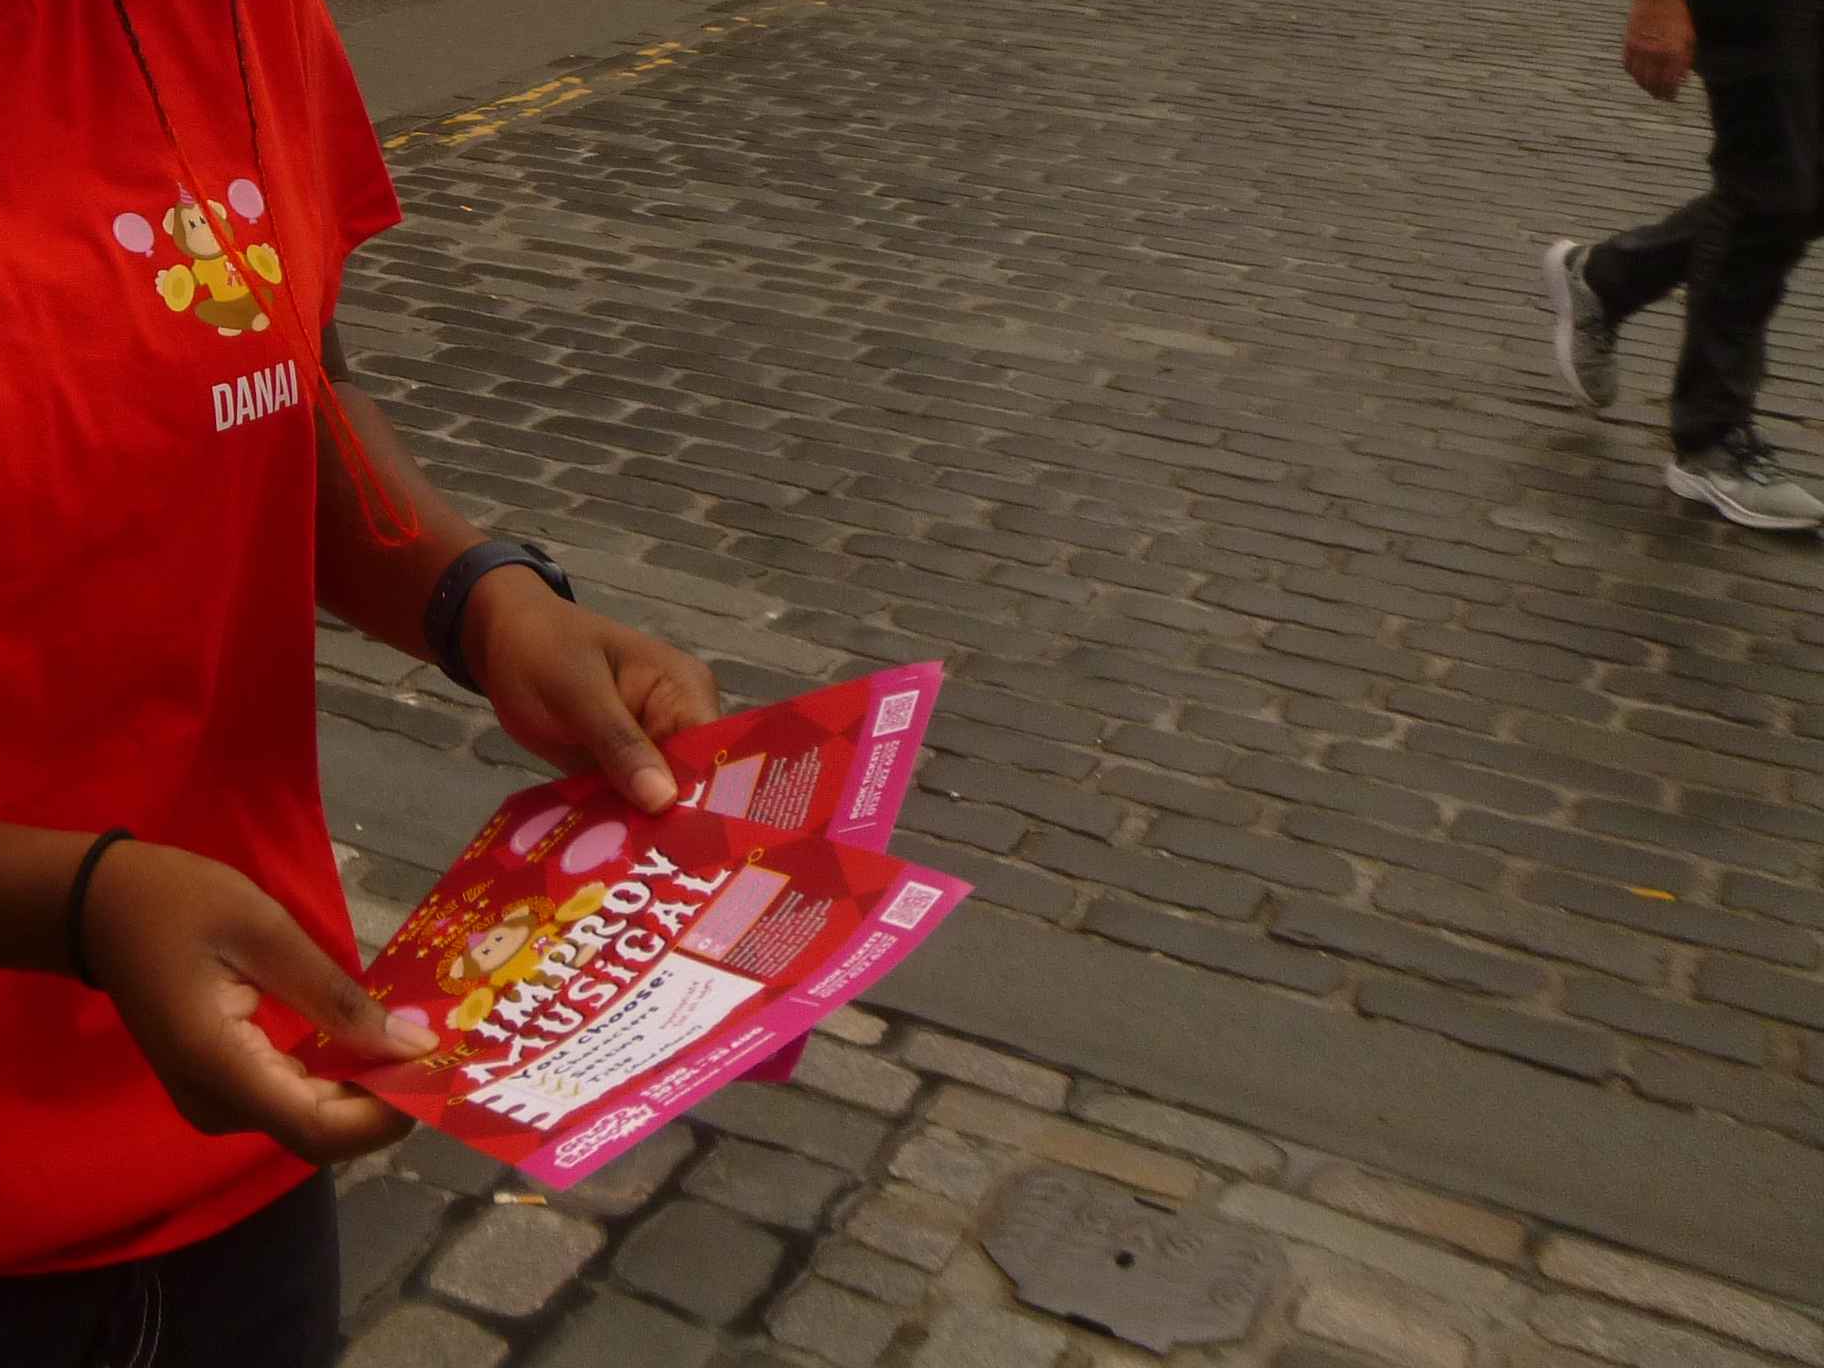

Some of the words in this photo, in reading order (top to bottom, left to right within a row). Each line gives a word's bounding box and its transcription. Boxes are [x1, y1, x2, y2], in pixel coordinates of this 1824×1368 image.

[212, 360, 299, 432] DANAI
[460, 867, 733, 1086] MUSICAL
[474, 845, 679, 1044] IMPROV
[510, 1049, 569, 1081] You
[578, 969, 674, 1044] choose:
[553, 1004, 660, 1076] Characters
[570, 1033, 645, 1079] Setting
[584, 1056, 633, 1083] Title
